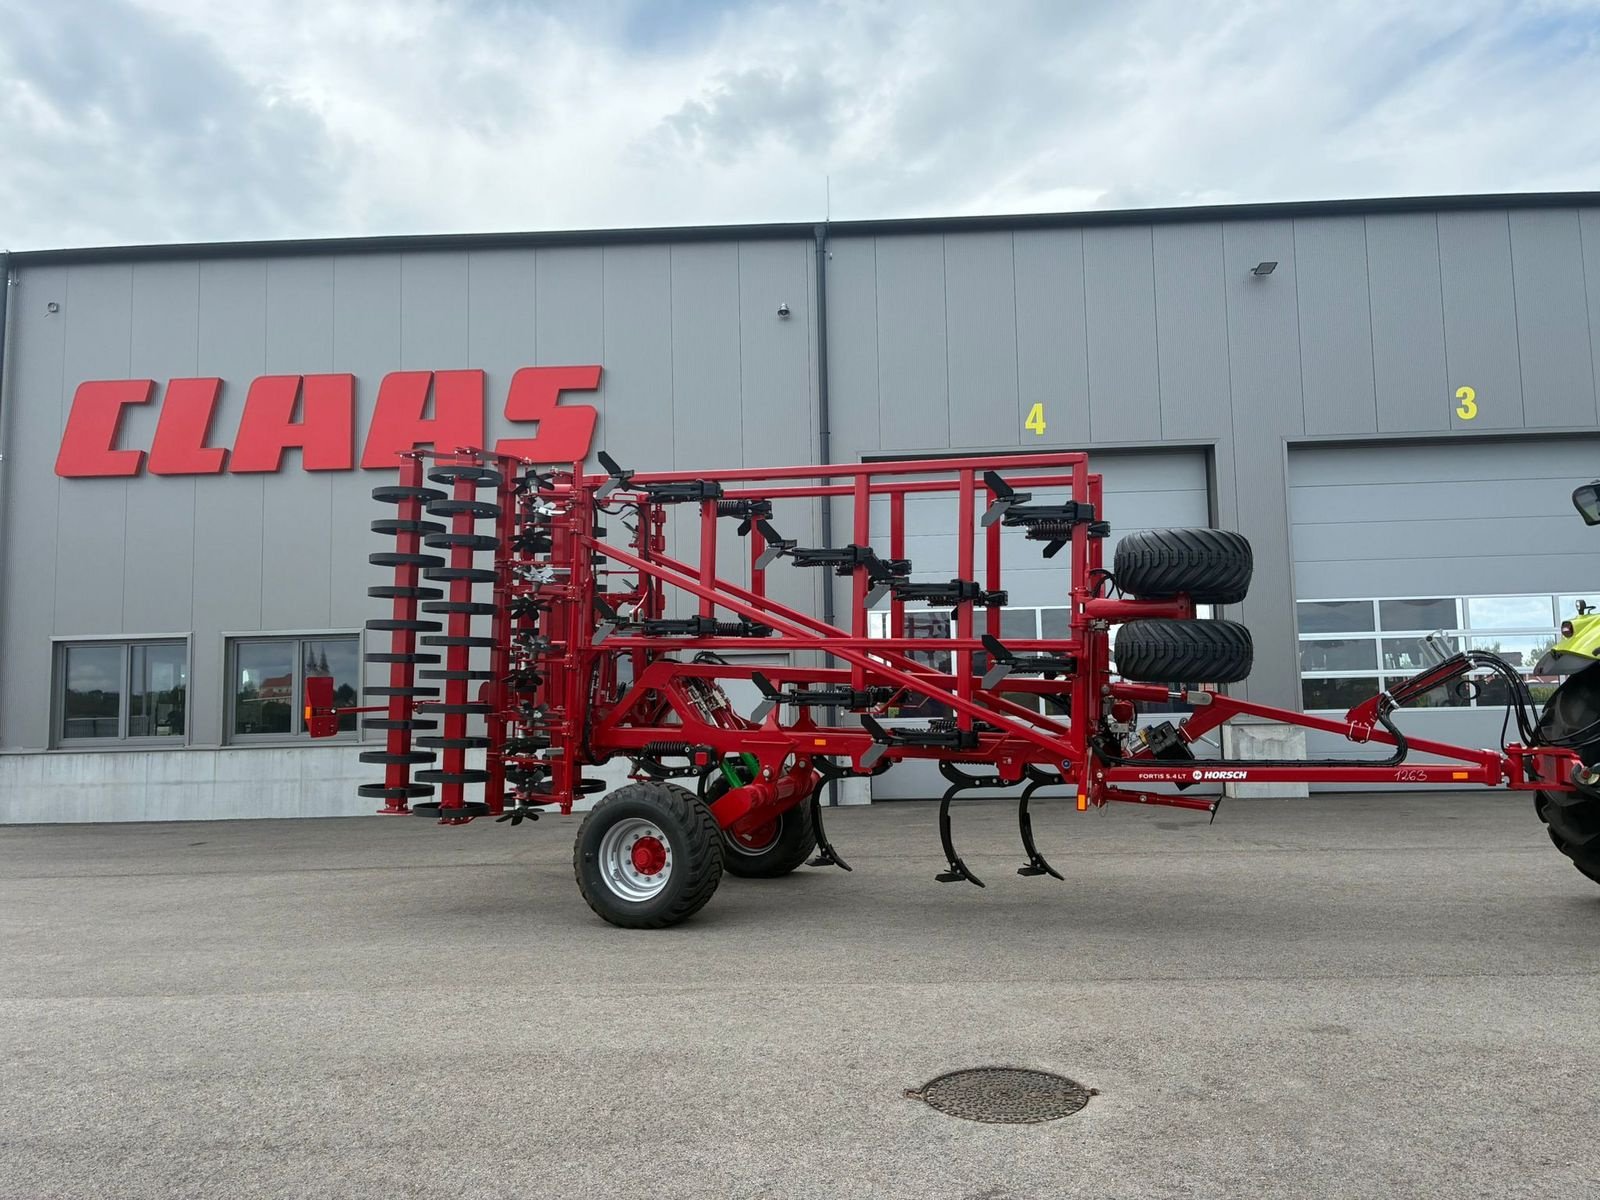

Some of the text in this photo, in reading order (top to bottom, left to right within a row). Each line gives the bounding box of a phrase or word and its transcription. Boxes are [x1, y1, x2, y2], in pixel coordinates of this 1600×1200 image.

[1024, 403, 1047, 435] 4
[1455, 386, 1478, 420] 3
[56, 365, 604, 478] CLAAS
[1204, 771, 1248, 779] HORSCH
[1394, 769, 1428, 781] 1263
